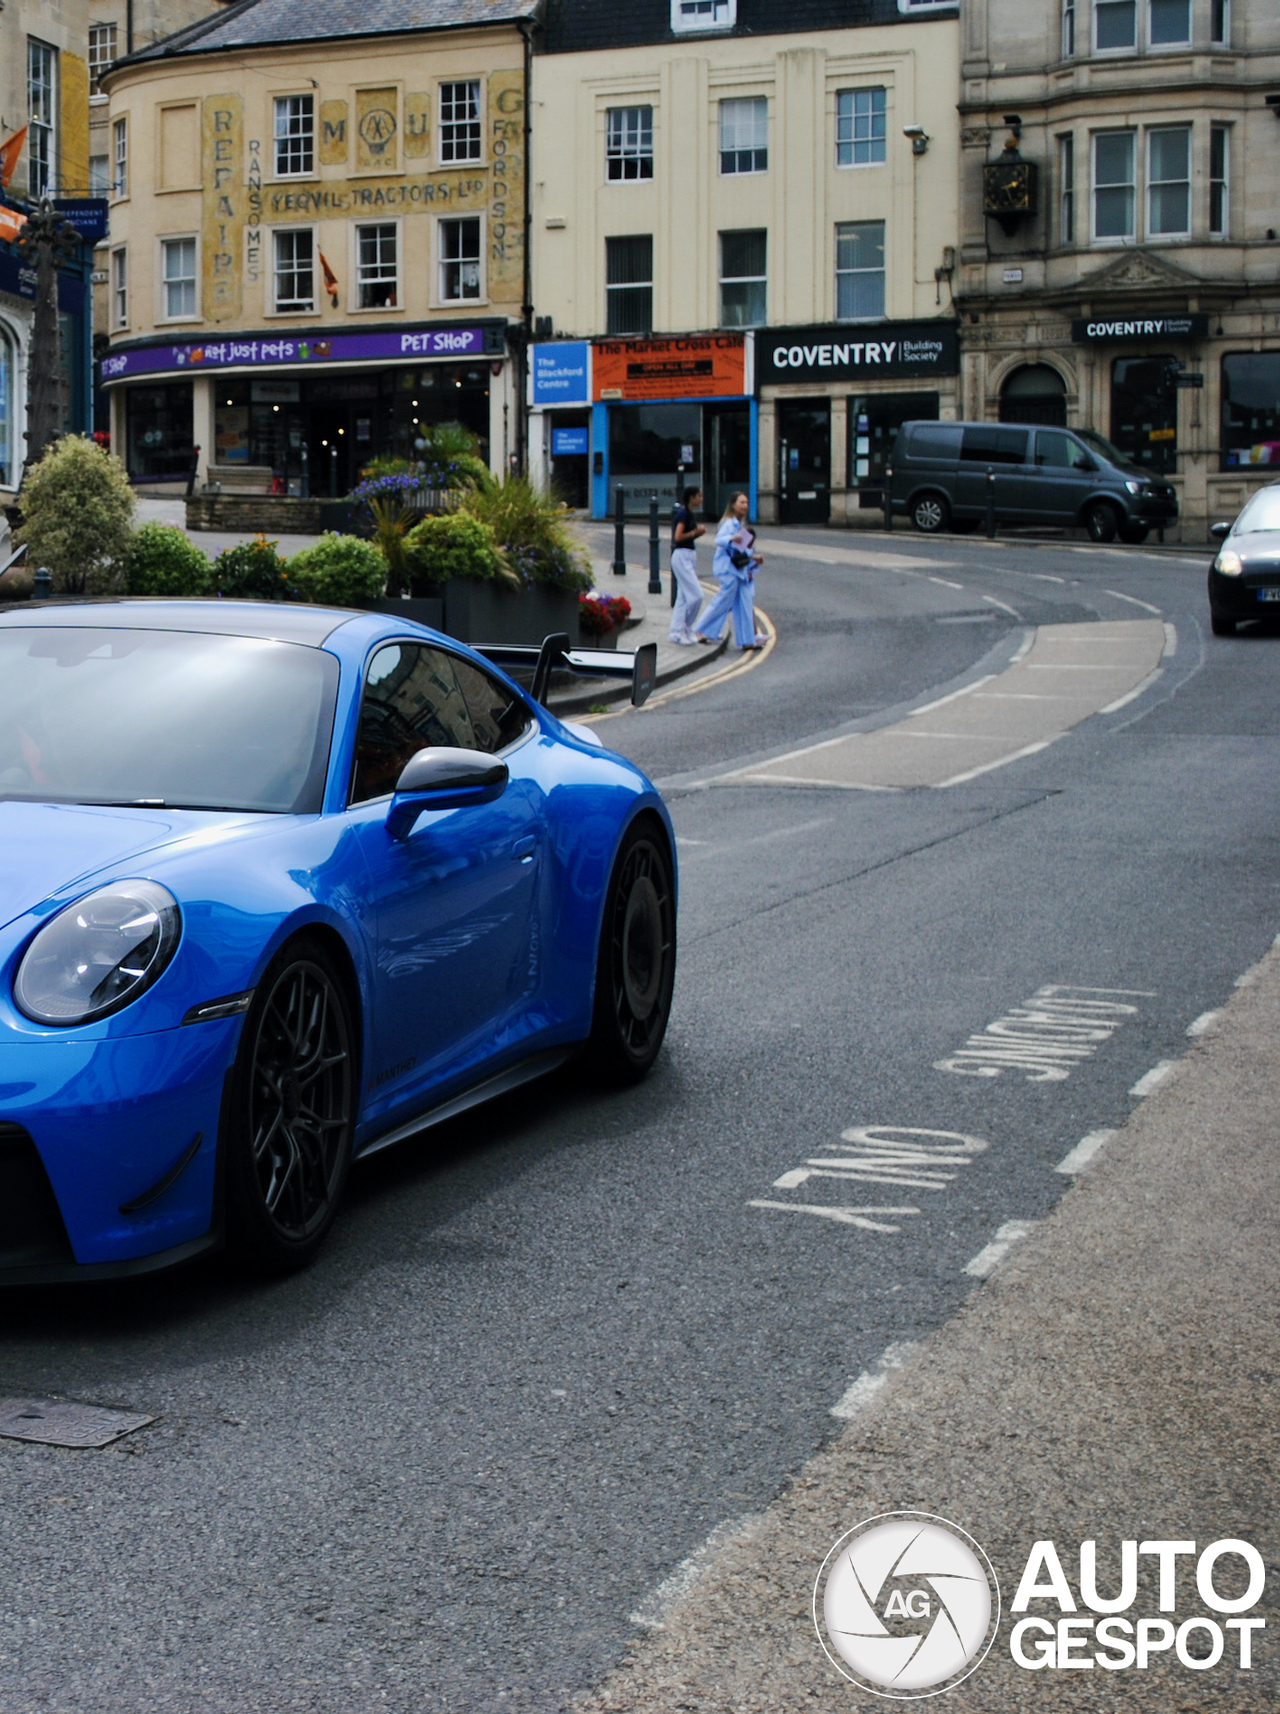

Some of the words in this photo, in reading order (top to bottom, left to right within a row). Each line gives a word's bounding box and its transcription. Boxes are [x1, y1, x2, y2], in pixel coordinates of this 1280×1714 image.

[351, 183, 448, 206] TRACTORS
[458, 179, 483, 199] LTD
[492, 119, 507, 261] FORDSON
[212, 110, 235, 304] REPAIRS
[247, 139, 263, 282] RANSOMES
[1086, 320, 1163, 336] COVENTRY
[204, 344, 227, 363] not
[227, 341, 258, 363] just
[261, 340, 294, 361] pets
[401, 333, 430, 352] PET
[598, 343, 620, 355] The
[625, 339, 671, 354] Market
[675, 337, 712, 351] Cross
[903, 340, 943, 354] Building
[537, 358, 556, 367] The
[772, 341, 897, 368] COVENTRY
[903, 350, 939, 363] Society
[537, 367, 584, 378] Blackford
[537, 379, 570, 389] Centre
[931, 983, 1158, 1083] LOADING
[743, 1123, 992, 1234] ONLY
